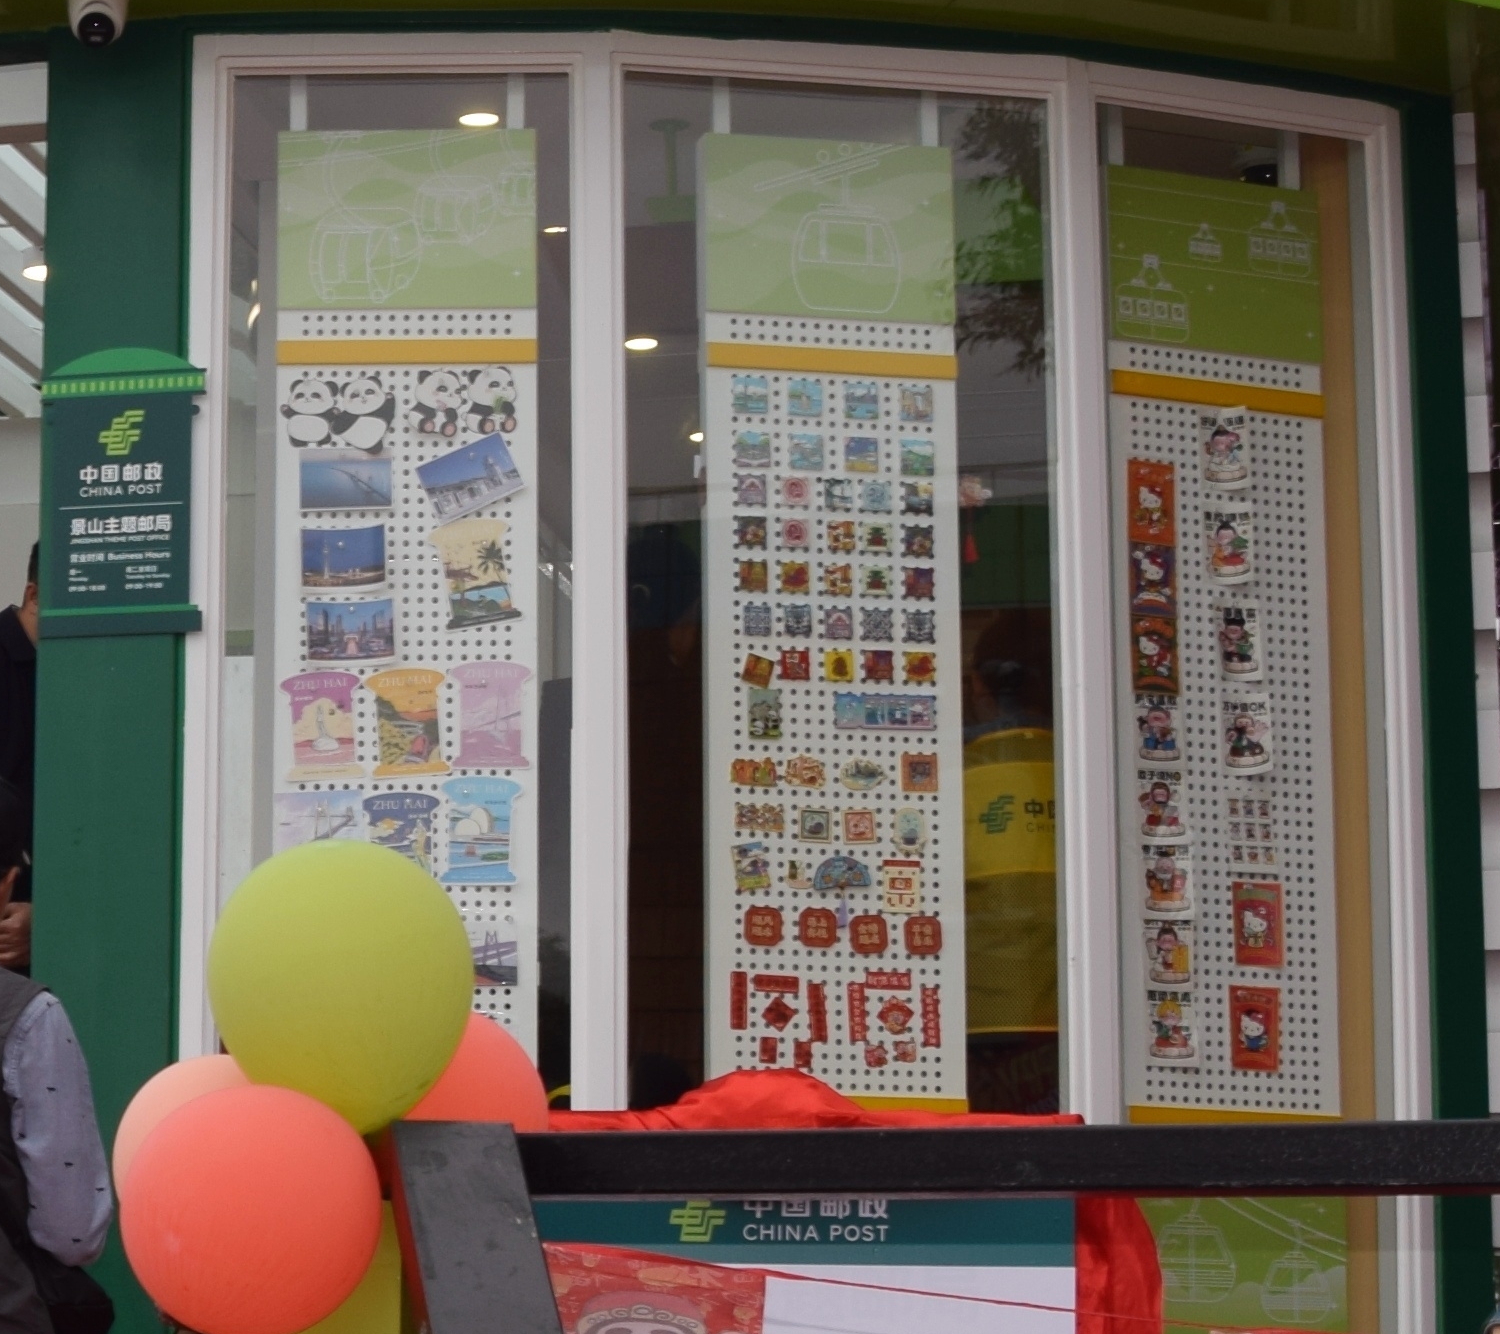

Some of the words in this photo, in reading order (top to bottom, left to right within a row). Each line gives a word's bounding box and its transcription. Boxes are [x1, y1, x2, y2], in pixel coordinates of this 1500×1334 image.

[79, 462, 163, 484] 中国邮政
[79, 485, 123, 498] CHINA
[128, 483, 163, 495] POST
[70, 514, 173, 536] 景山主题邮局
[128, 534, 146, 543] POST
[146, 533, 171, 542] OFFICE
[107, 551, 144, 562] Business
[145, 550, 171, 560] Hours
[293, 680, 321, 692] ZHU
[324, 677, 347, 689] HAI
[377, 676, 405, 688] ZHU
[408, 675, 433, 686] HAI
[372, 799, 400, 811] ZHU
[404, 798, 428, 810] HAI
[742, 1224, 820, 1243] CHINA
[829, 1224, 890, 1243] POST
